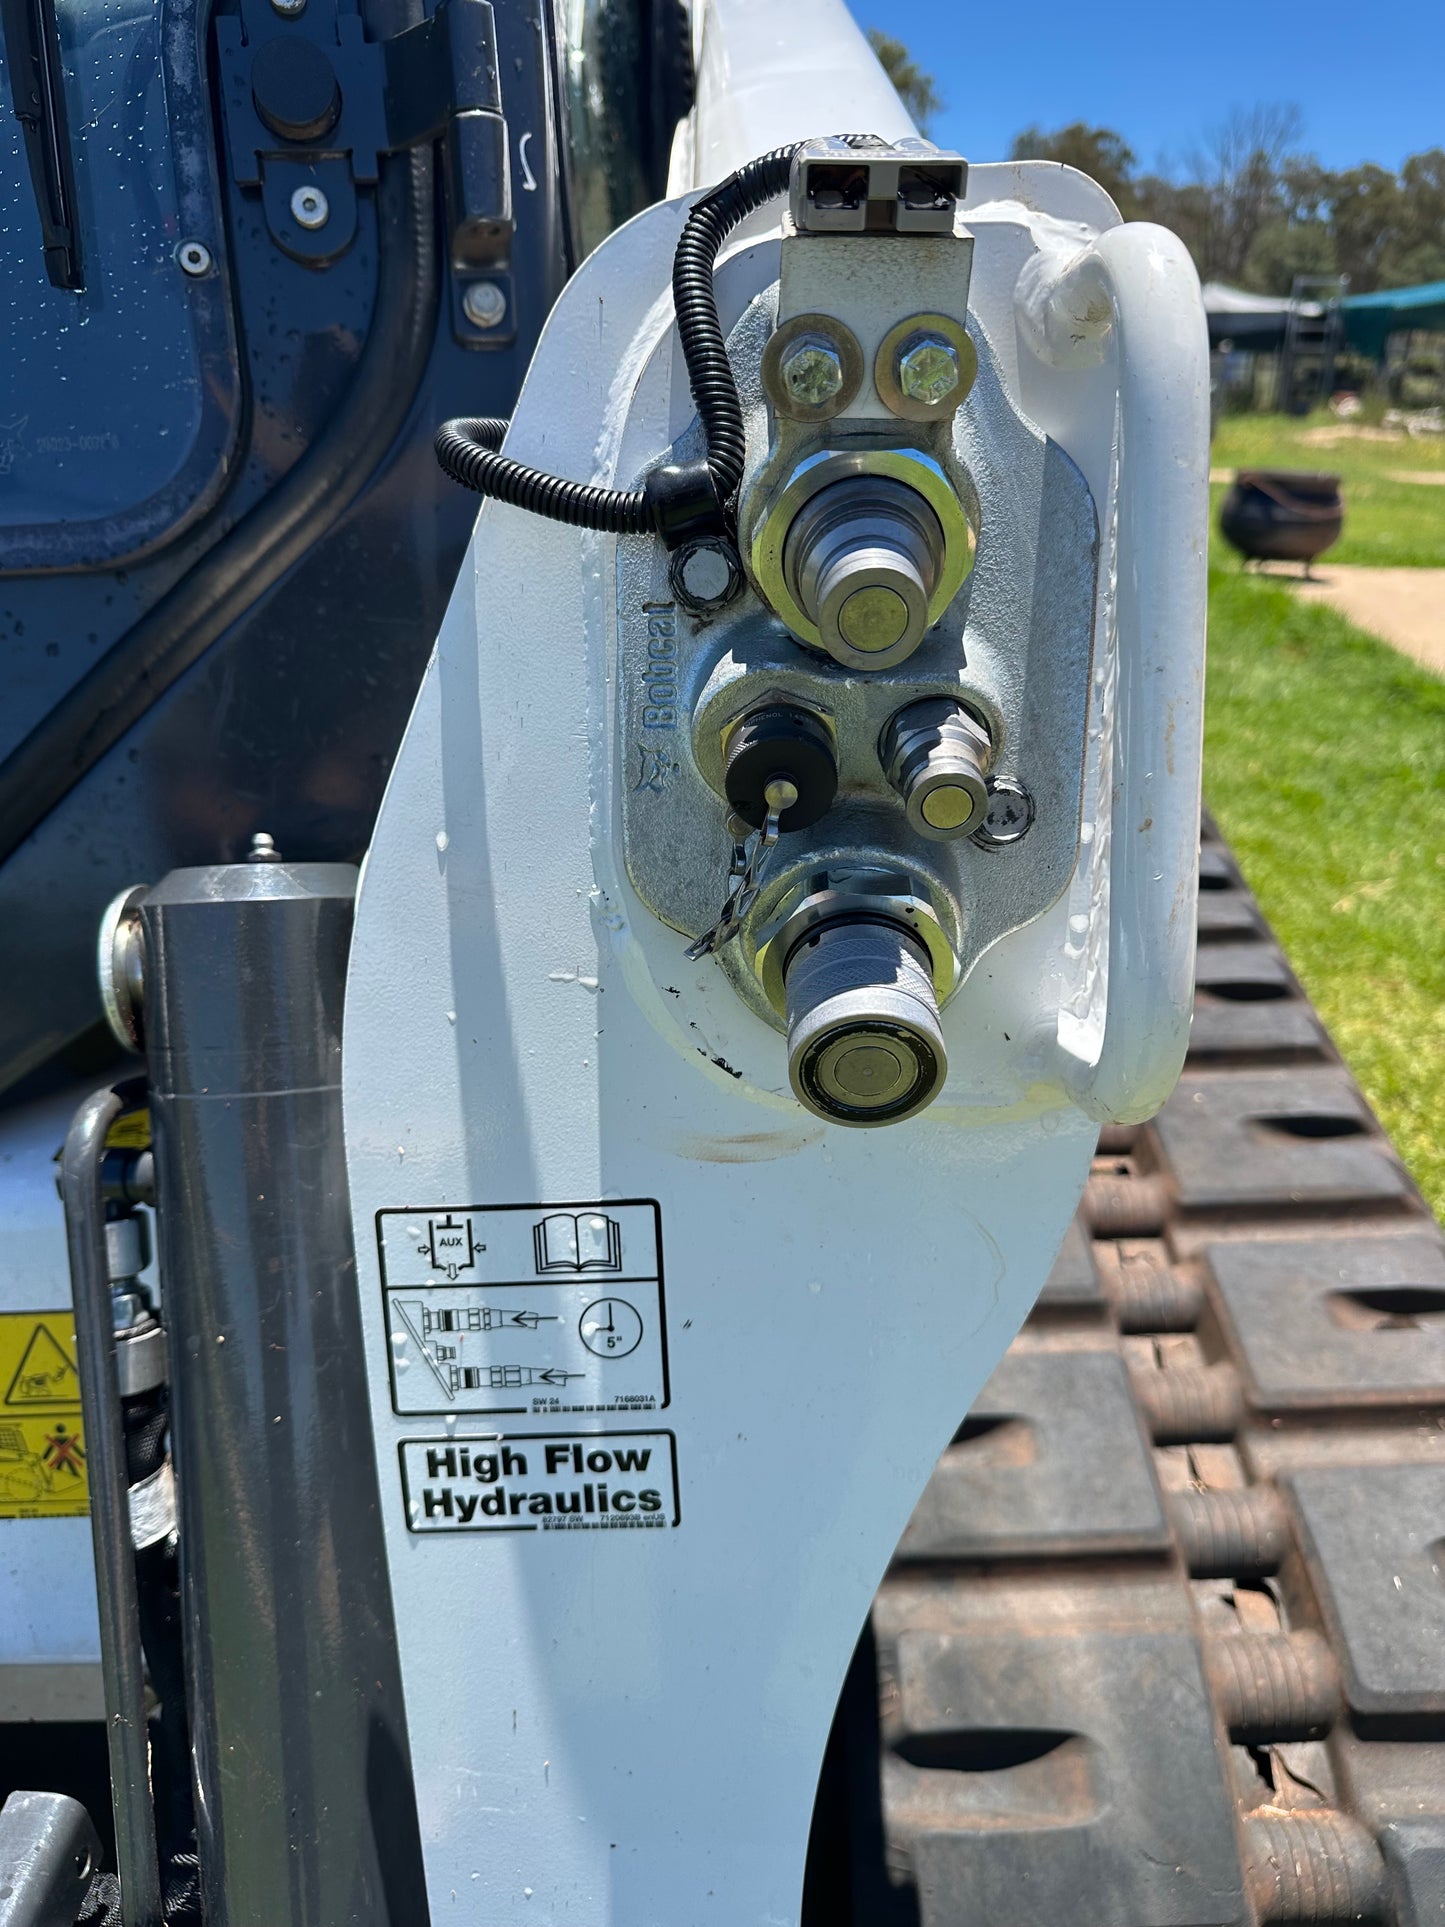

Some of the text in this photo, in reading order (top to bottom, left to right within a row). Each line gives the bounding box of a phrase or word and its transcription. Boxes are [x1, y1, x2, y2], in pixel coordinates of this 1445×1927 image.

[641, 600, 678, 729] Bobcat
[439, 1237, 463, 1248] AUX
[532, 1397, 548, 1406] SW
[549, 1397, 560, 1405] 24
[426, 1443, 652, 1482] High Flow
[423, 1483, 662, 1522] Hydraulics
